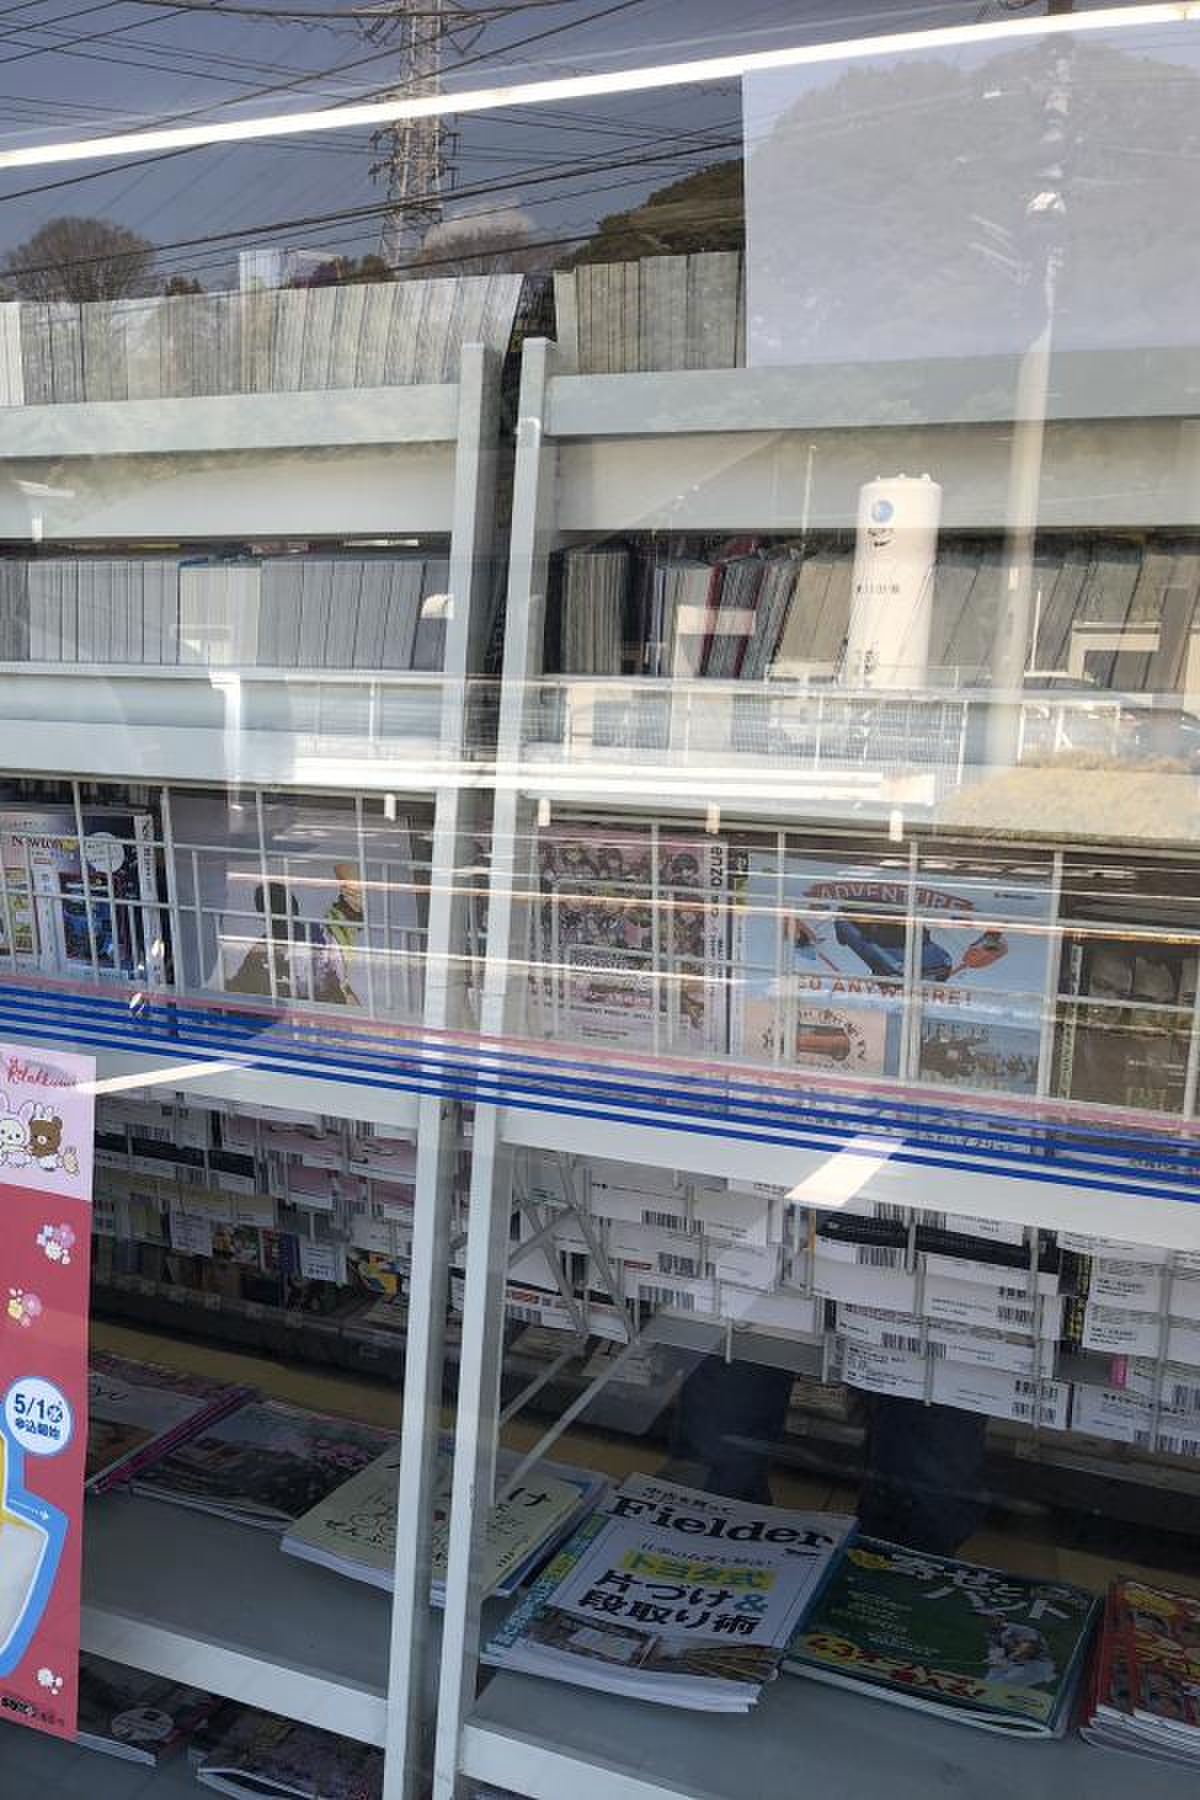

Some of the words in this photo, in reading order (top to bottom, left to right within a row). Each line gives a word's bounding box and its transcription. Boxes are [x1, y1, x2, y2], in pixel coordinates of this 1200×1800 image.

[832, 981, 974, 1003] ANYWERE!
[604, 1494, 834, 1549] Fielder
[577, 1588, 763, 1635] 段取り術
